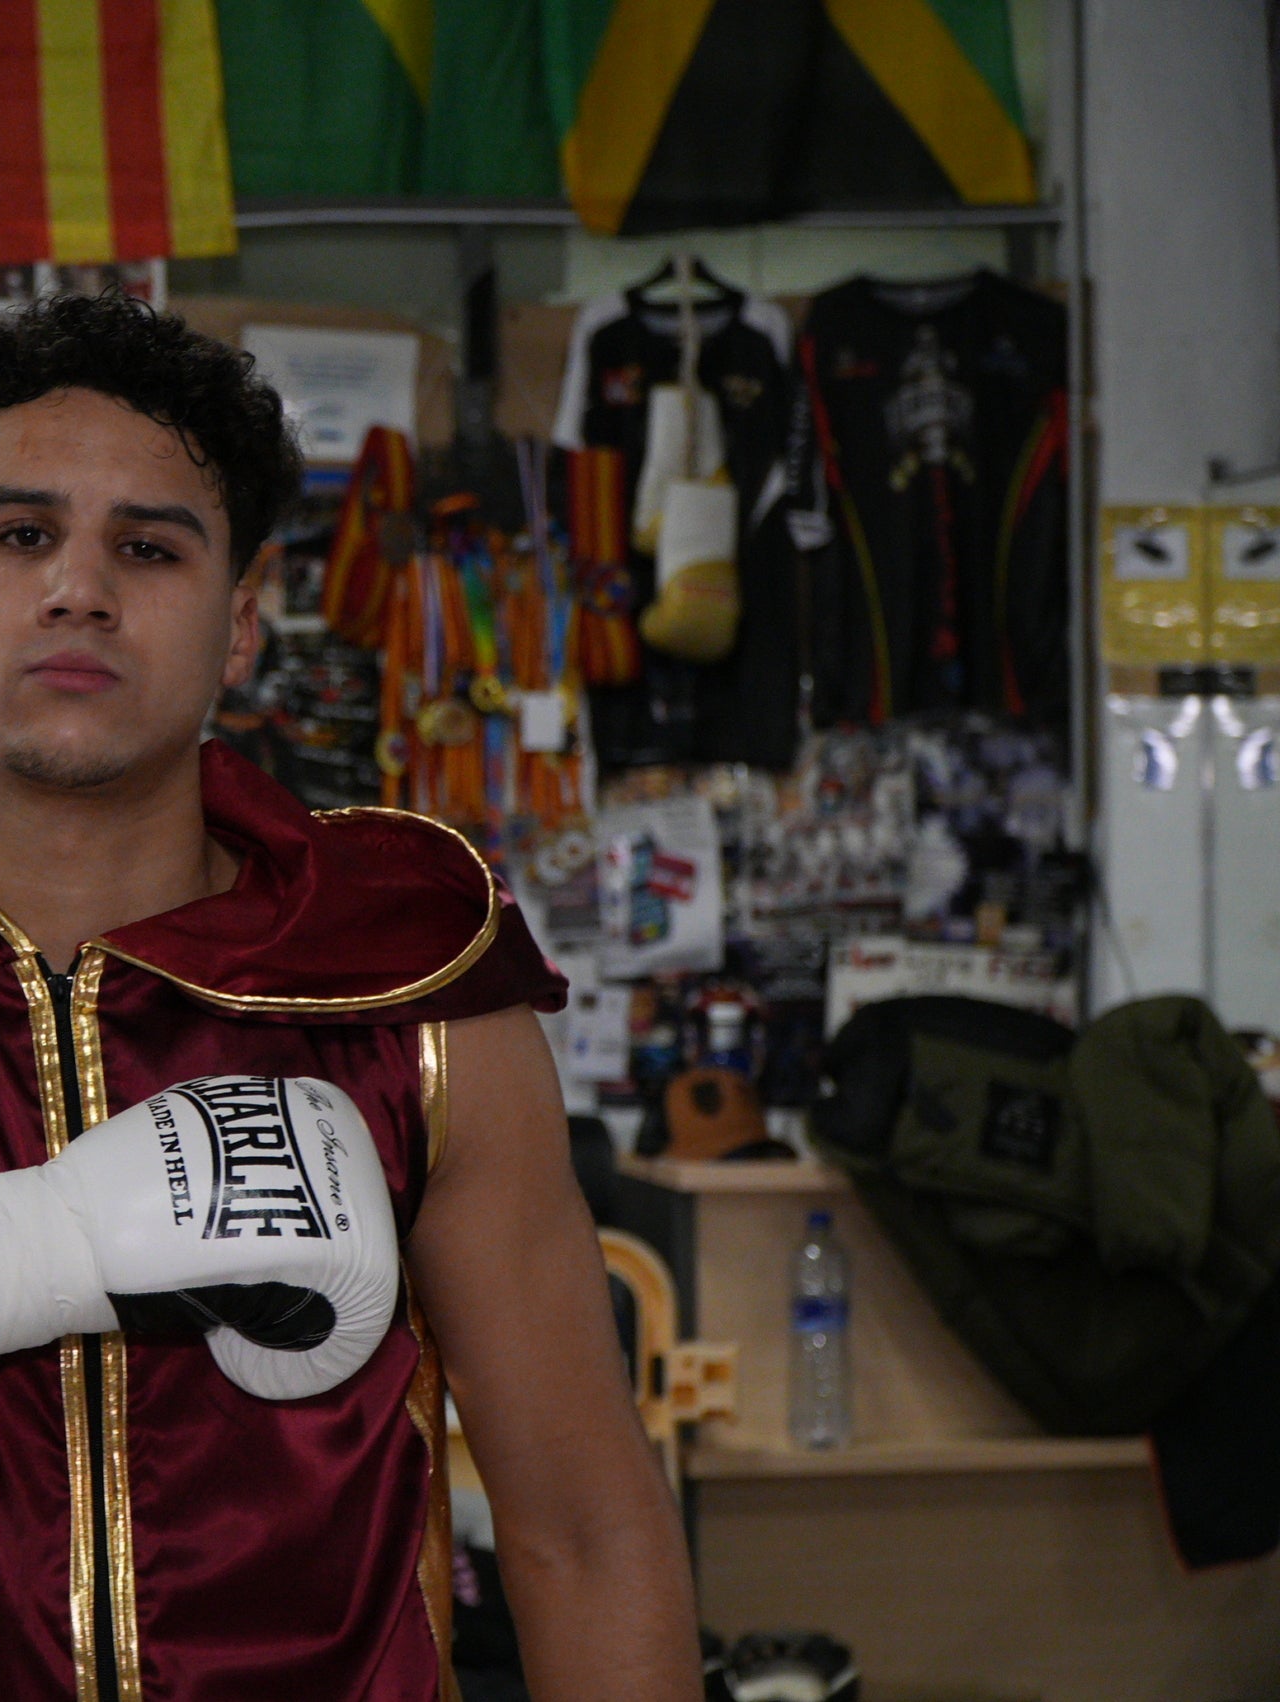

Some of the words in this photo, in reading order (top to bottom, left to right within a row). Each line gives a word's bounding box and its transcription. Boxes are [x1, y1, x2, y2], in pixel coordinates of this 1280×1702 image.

[158, 1131, 183, 1154] IN
[315, 1117, 349, 1207] Insane
[164, 1156, 194, 1226] HELL
